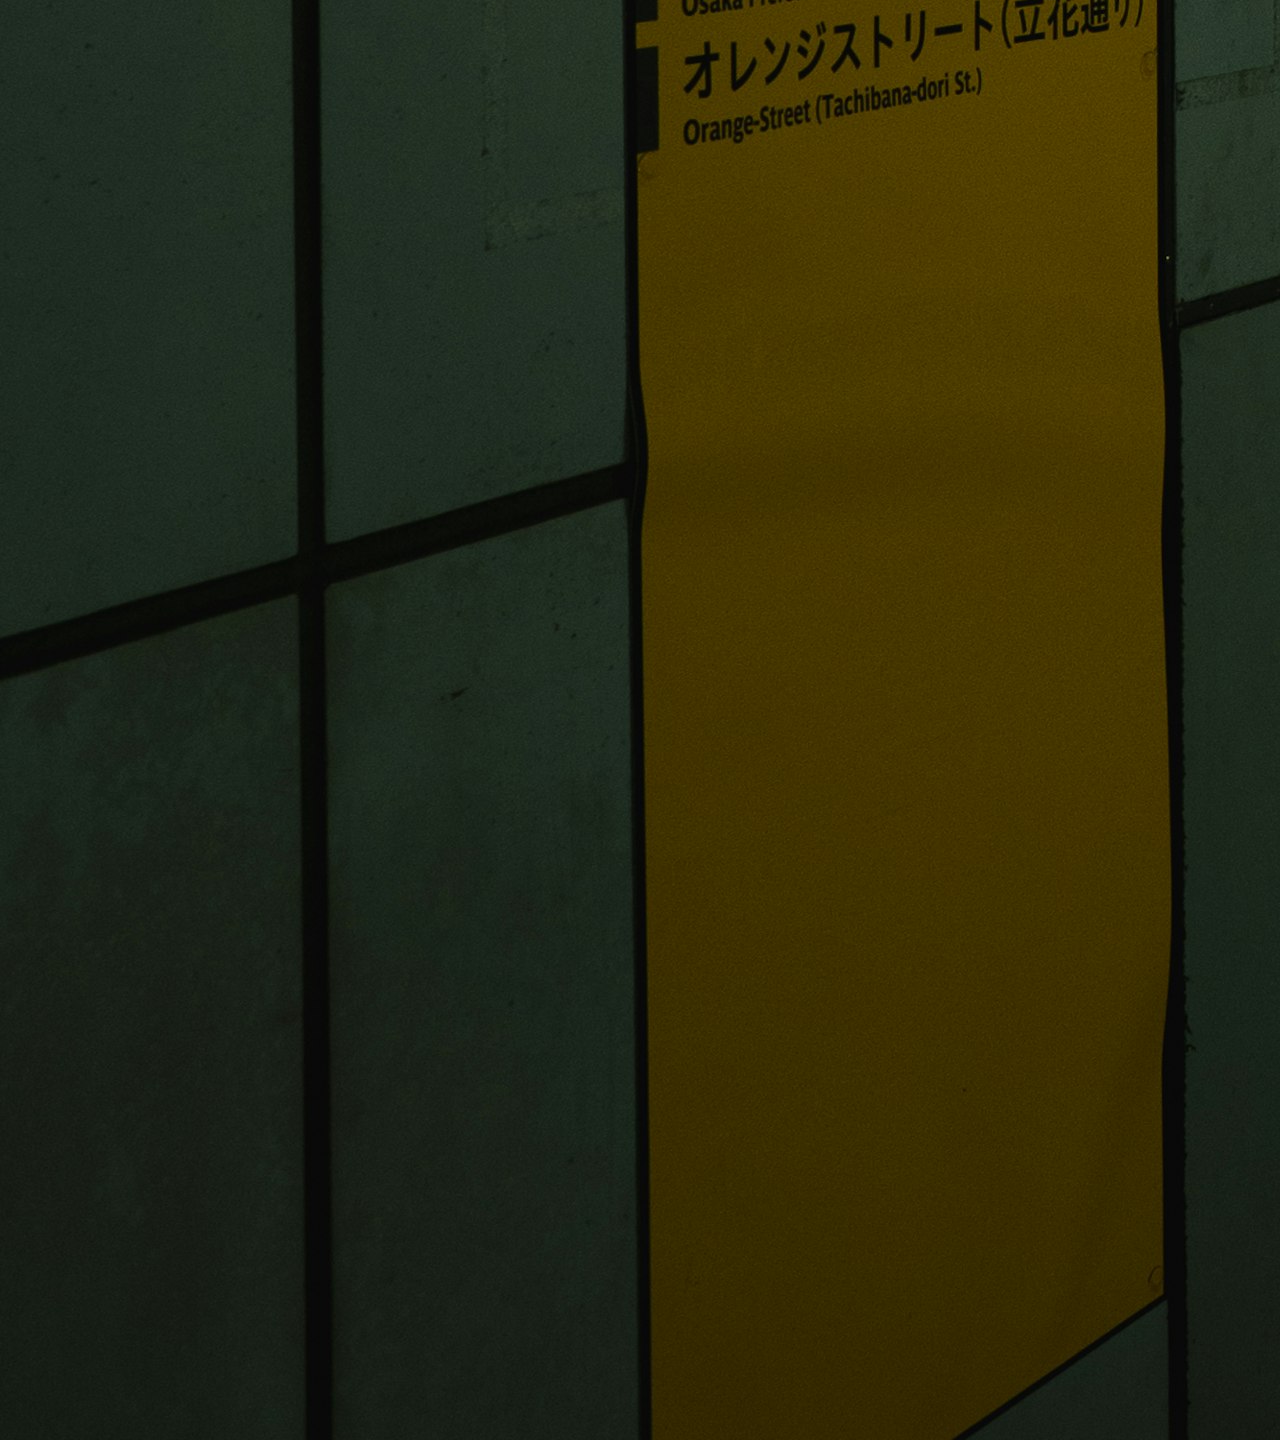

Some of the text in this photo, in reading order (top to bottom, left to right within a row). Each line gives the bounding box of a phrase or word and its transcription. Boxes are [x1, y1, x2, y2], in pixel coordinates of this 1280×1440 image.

[683, 68, 982, 145] Orange-Street (Tachibana-dori St.)
